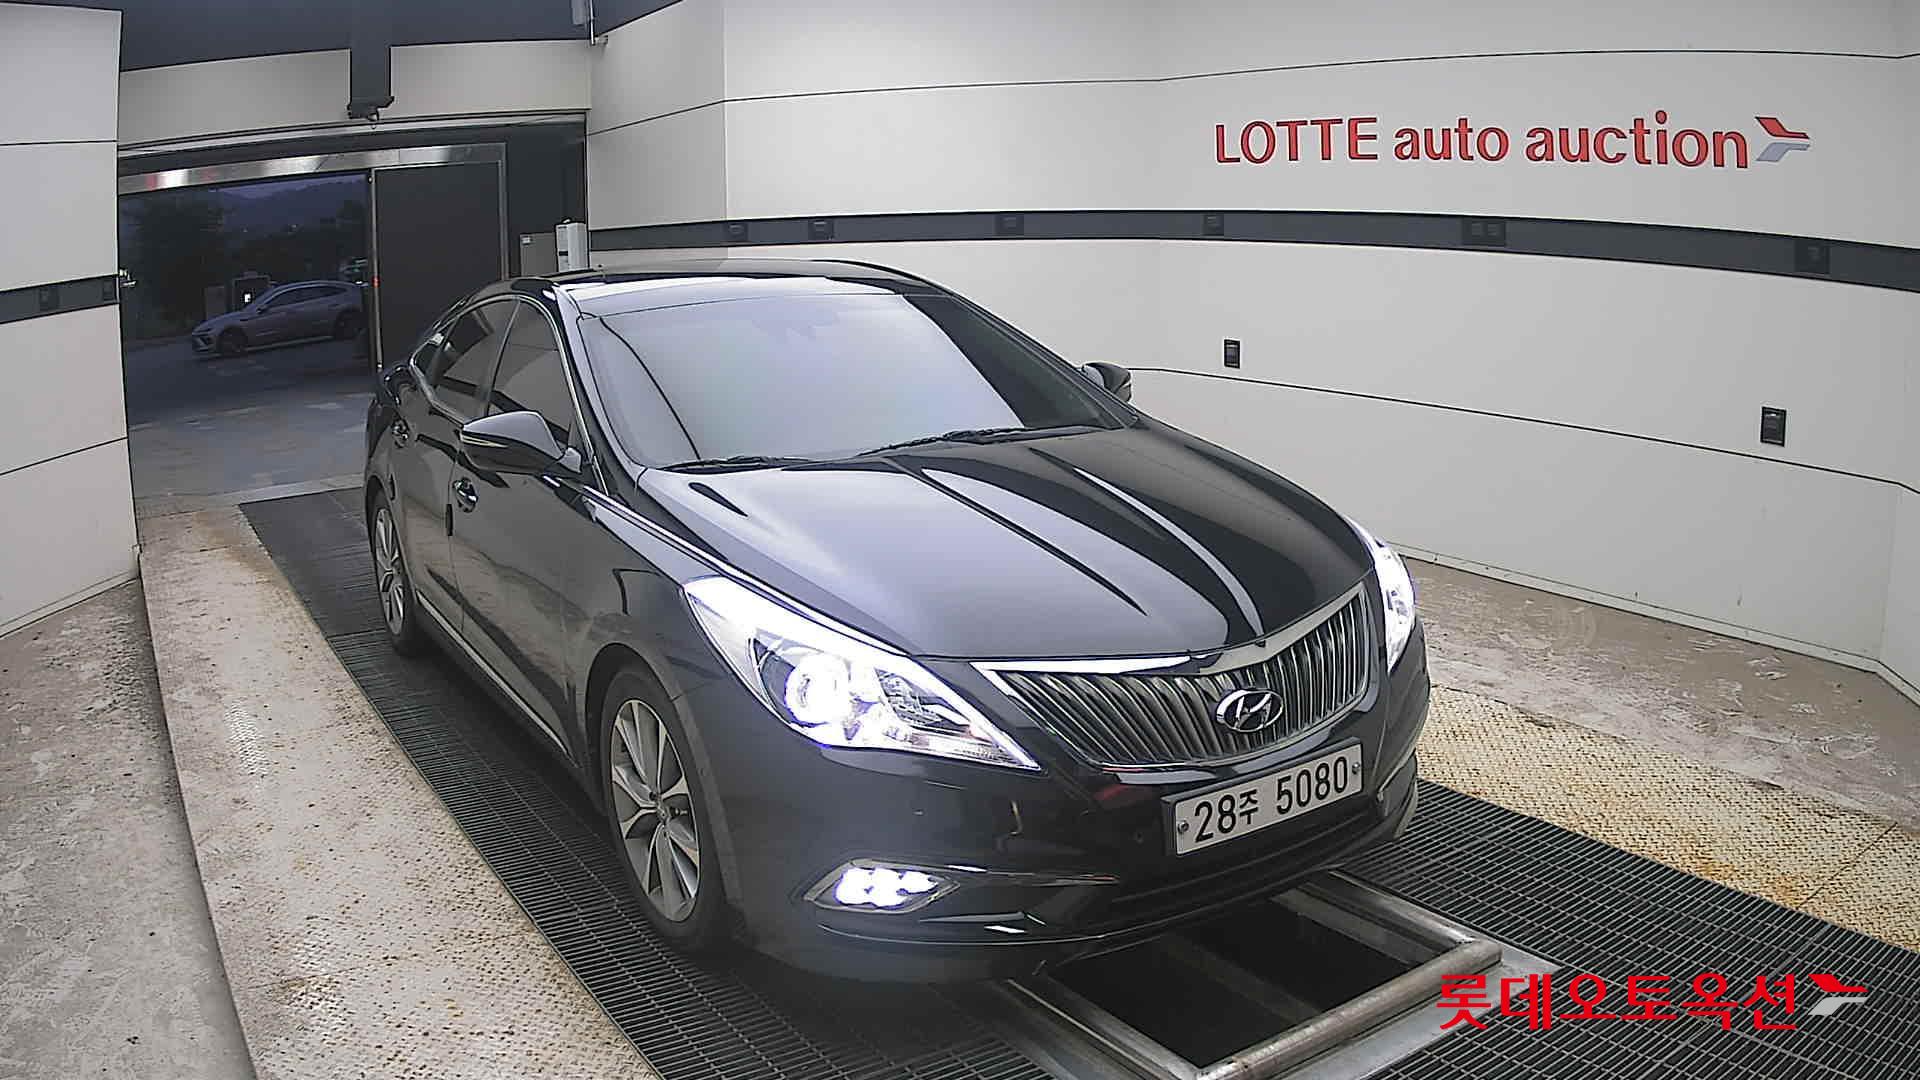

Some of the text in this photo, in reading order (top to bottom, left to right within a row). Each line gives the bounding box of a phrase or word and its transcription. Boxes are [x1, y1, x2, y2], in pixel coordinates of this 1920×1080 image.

[1215, 110, 1749, 169] LOTTE auto auction
[1194, 756, 1348, 843] 28주 5080
